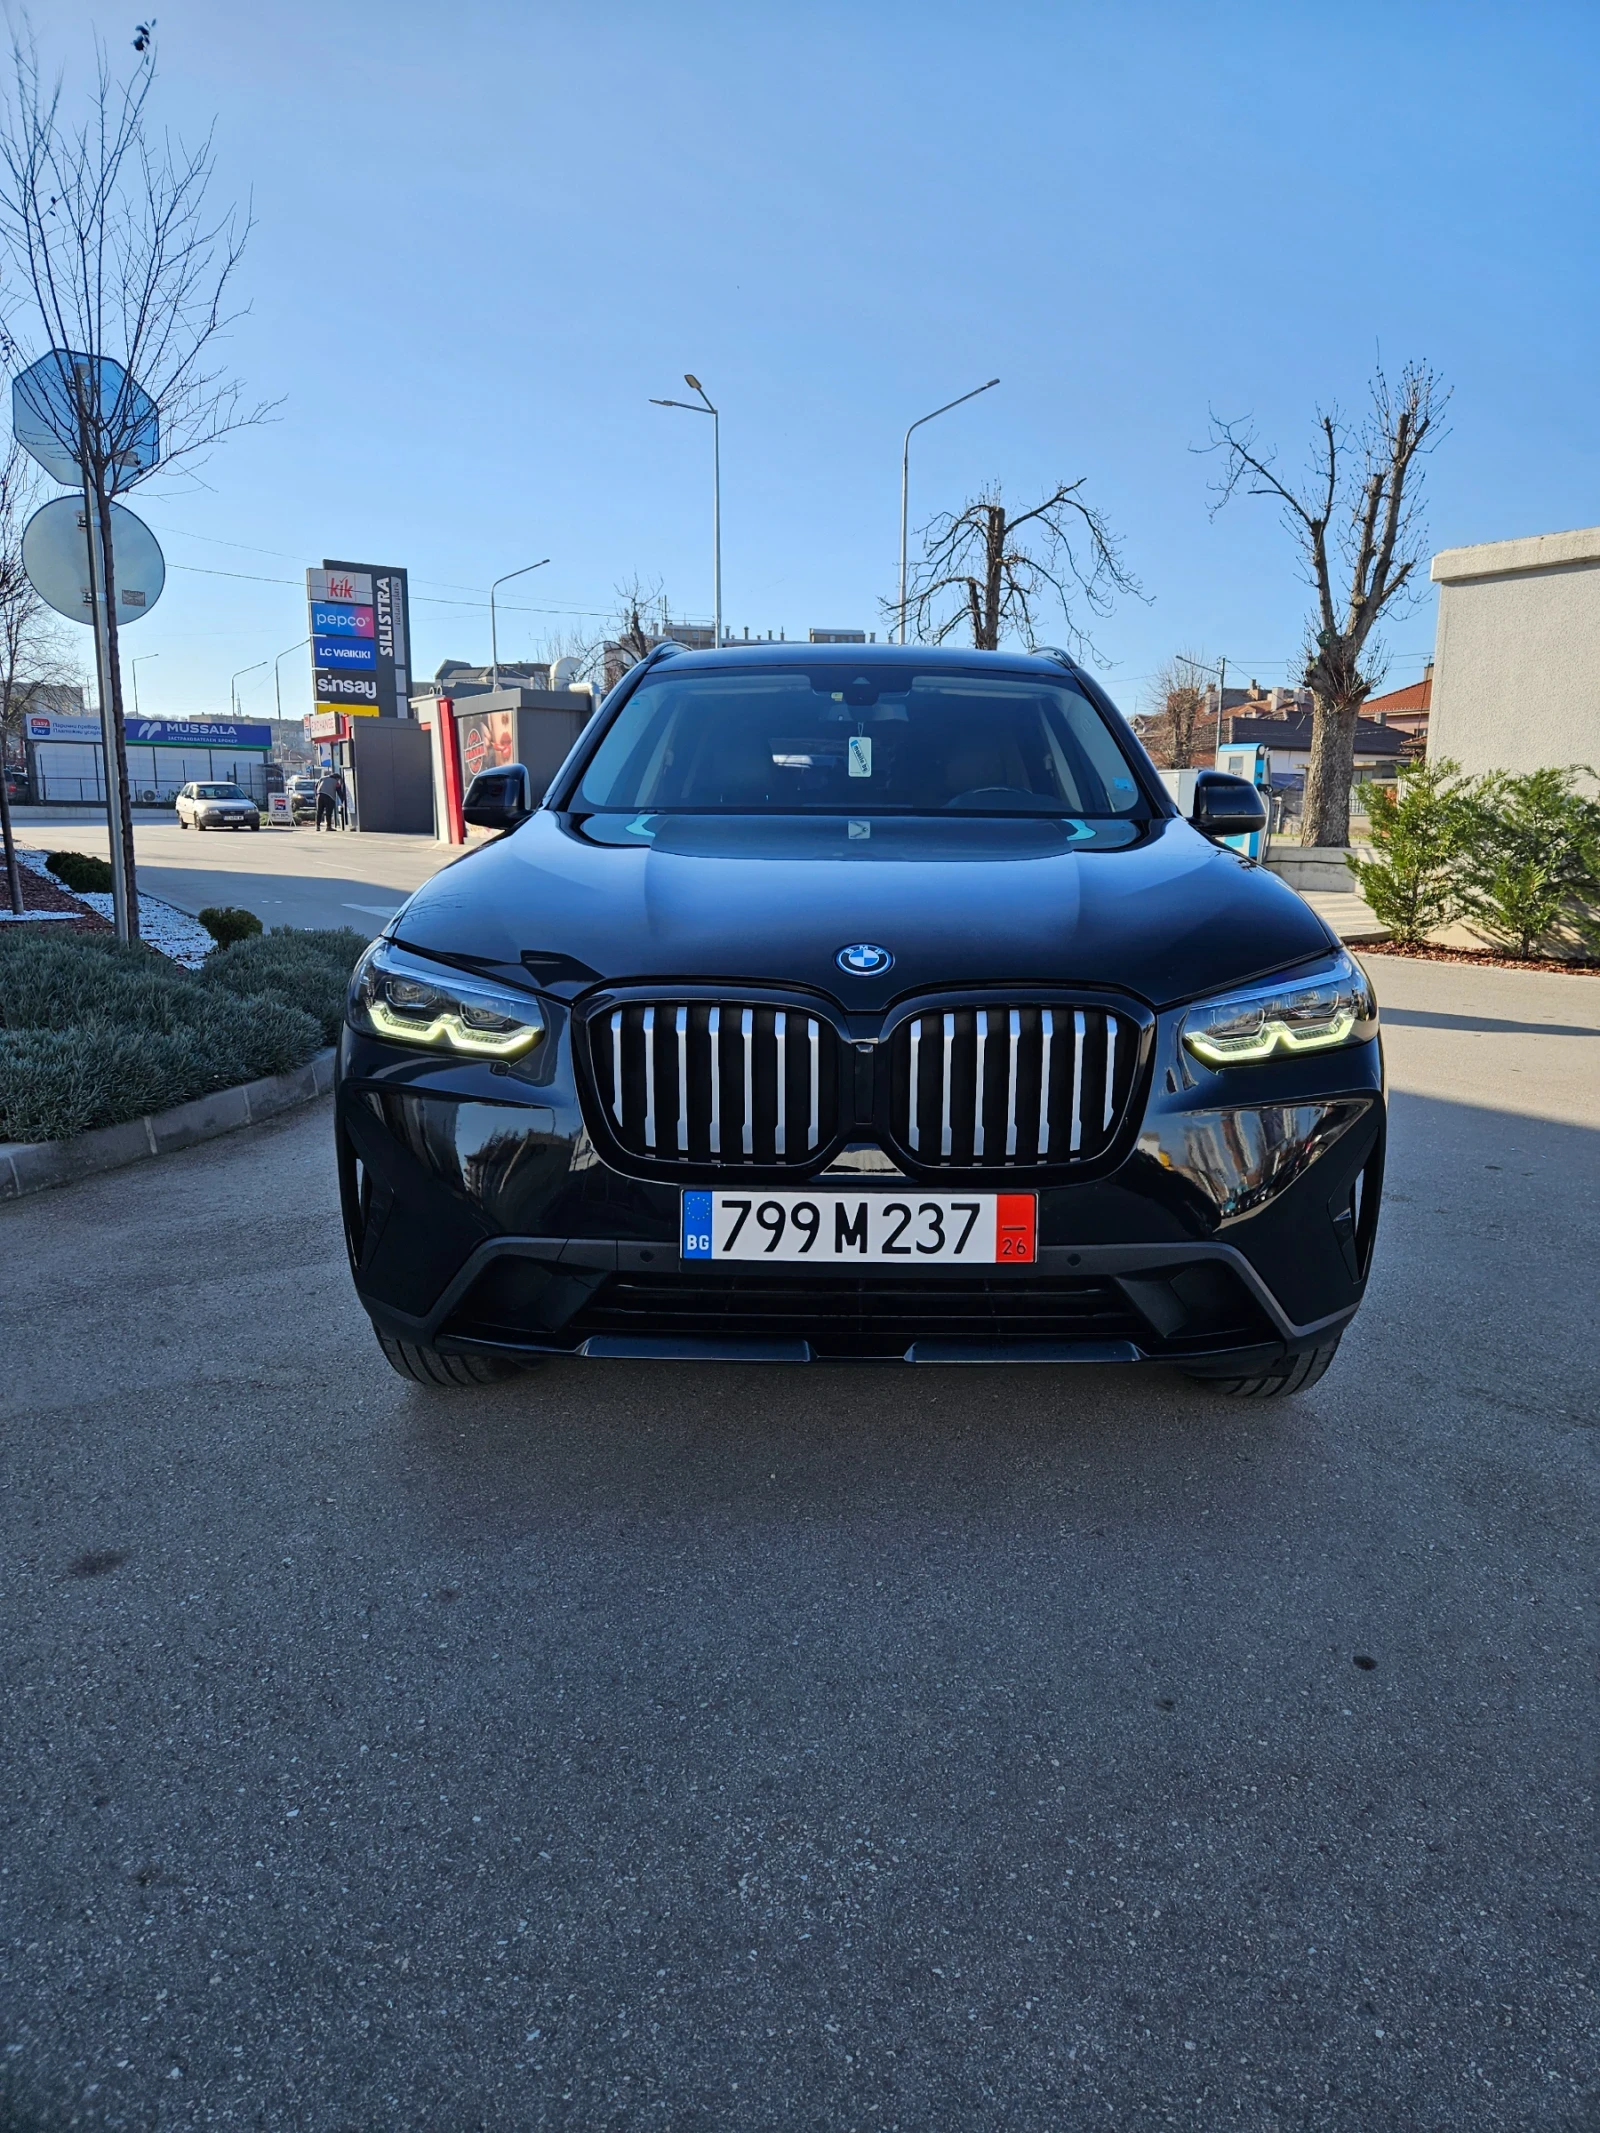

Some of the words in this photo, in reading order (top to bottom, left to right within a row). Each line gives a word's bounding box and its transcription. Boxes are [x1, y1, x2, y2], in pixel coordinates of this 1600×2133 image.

[330, 576, 353, 599] kik
[376, 576, 393, 657] SILISTRA
[319, 647, 332, 657] LC
[317, 675, 377, 700] sinsay
[32, 719, 48, 727] Easy
[166, 722, 237, 735] MUSSALA
[311, 717, 335, 732] EXCHANGE
[33, 727, 46, 735] Pay
[844, 945, 885, 955] BMW
[721, 1200, 821, 1253] 799
[881, 1202, 981, 1255] 237
[686, 1234, 710, 1250] BG
[1002, 1238, 1027, 1256] 26
